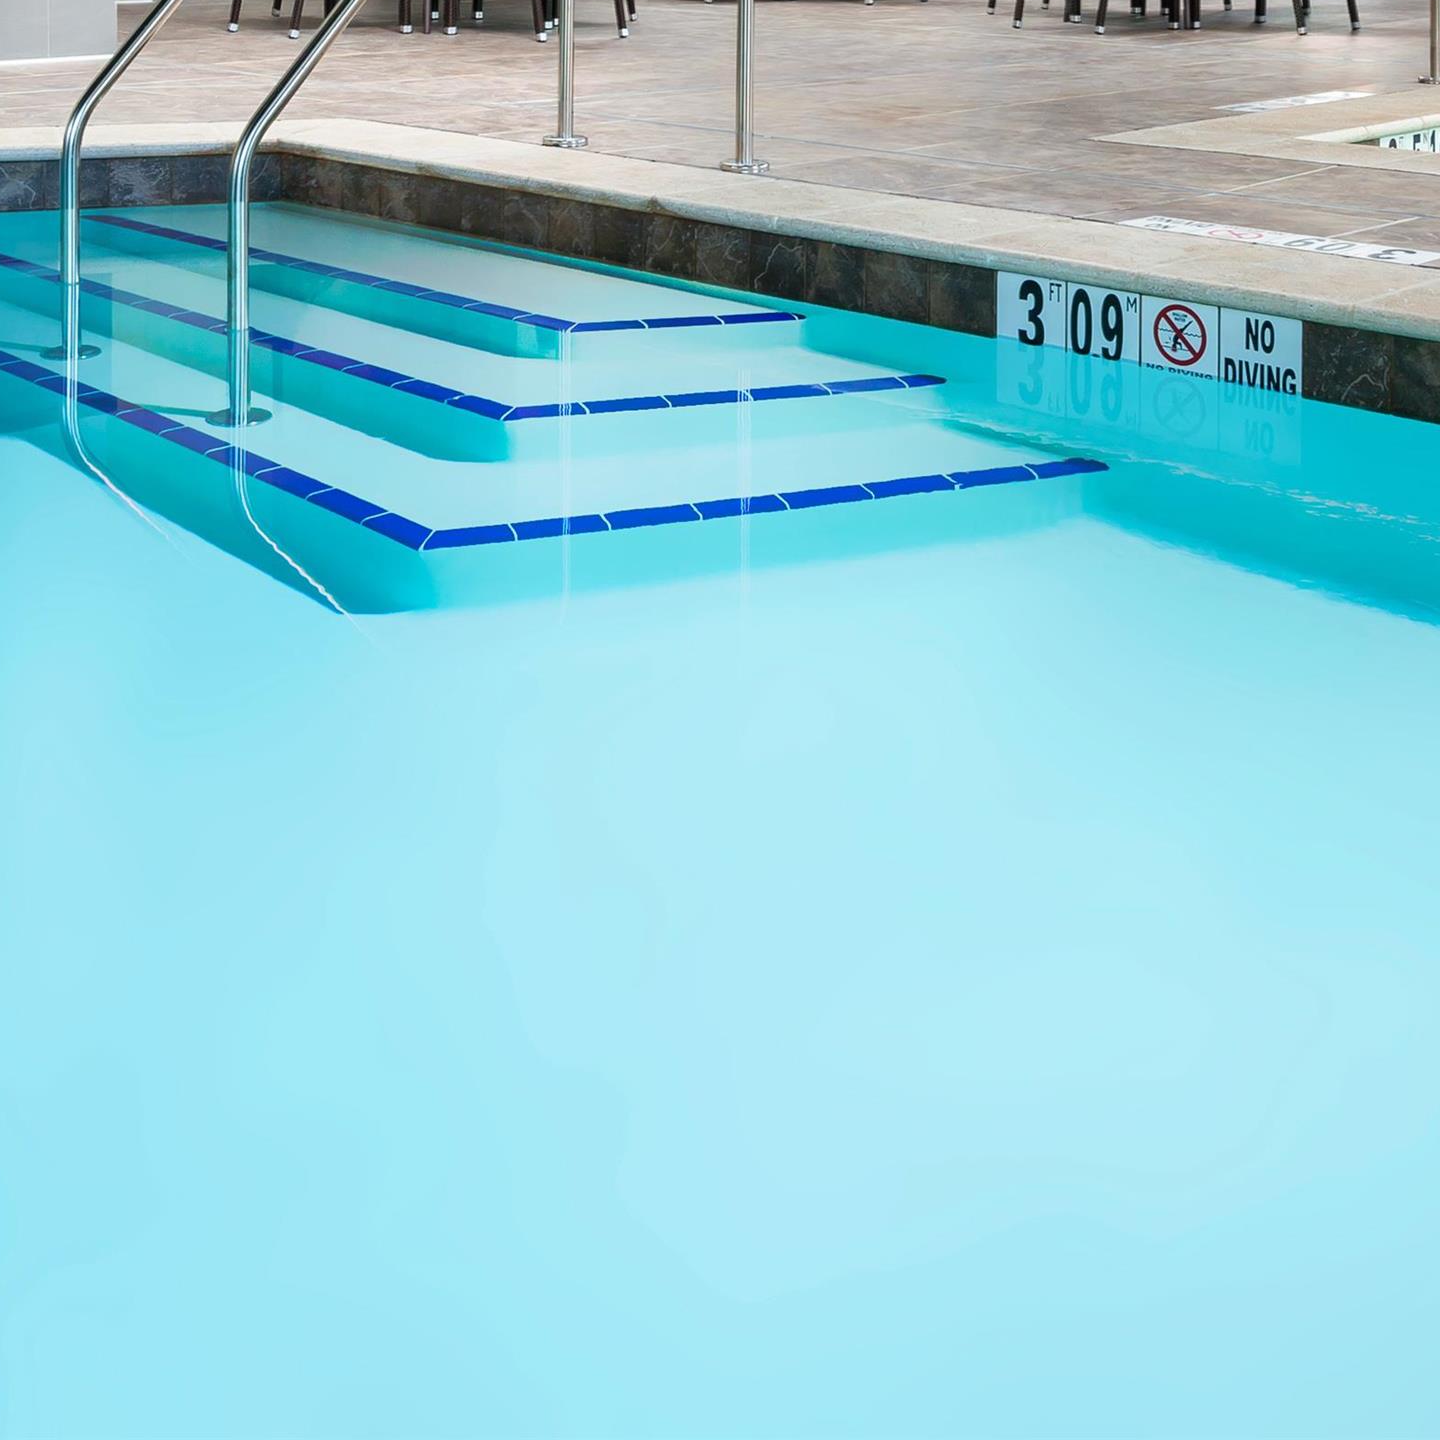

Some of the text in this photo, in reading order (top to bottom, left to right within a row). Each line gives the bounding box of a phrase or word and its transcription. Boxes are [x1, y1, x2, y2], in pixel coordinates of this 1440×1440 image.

[1018, 279, 1045, 346] 3
[1049, 282, 1062, 303] FT
[1126, 296, 1137, 313] M
[1245, 317, 1275, 354] NO
[1224, 357, 1296, 395] DIVING
